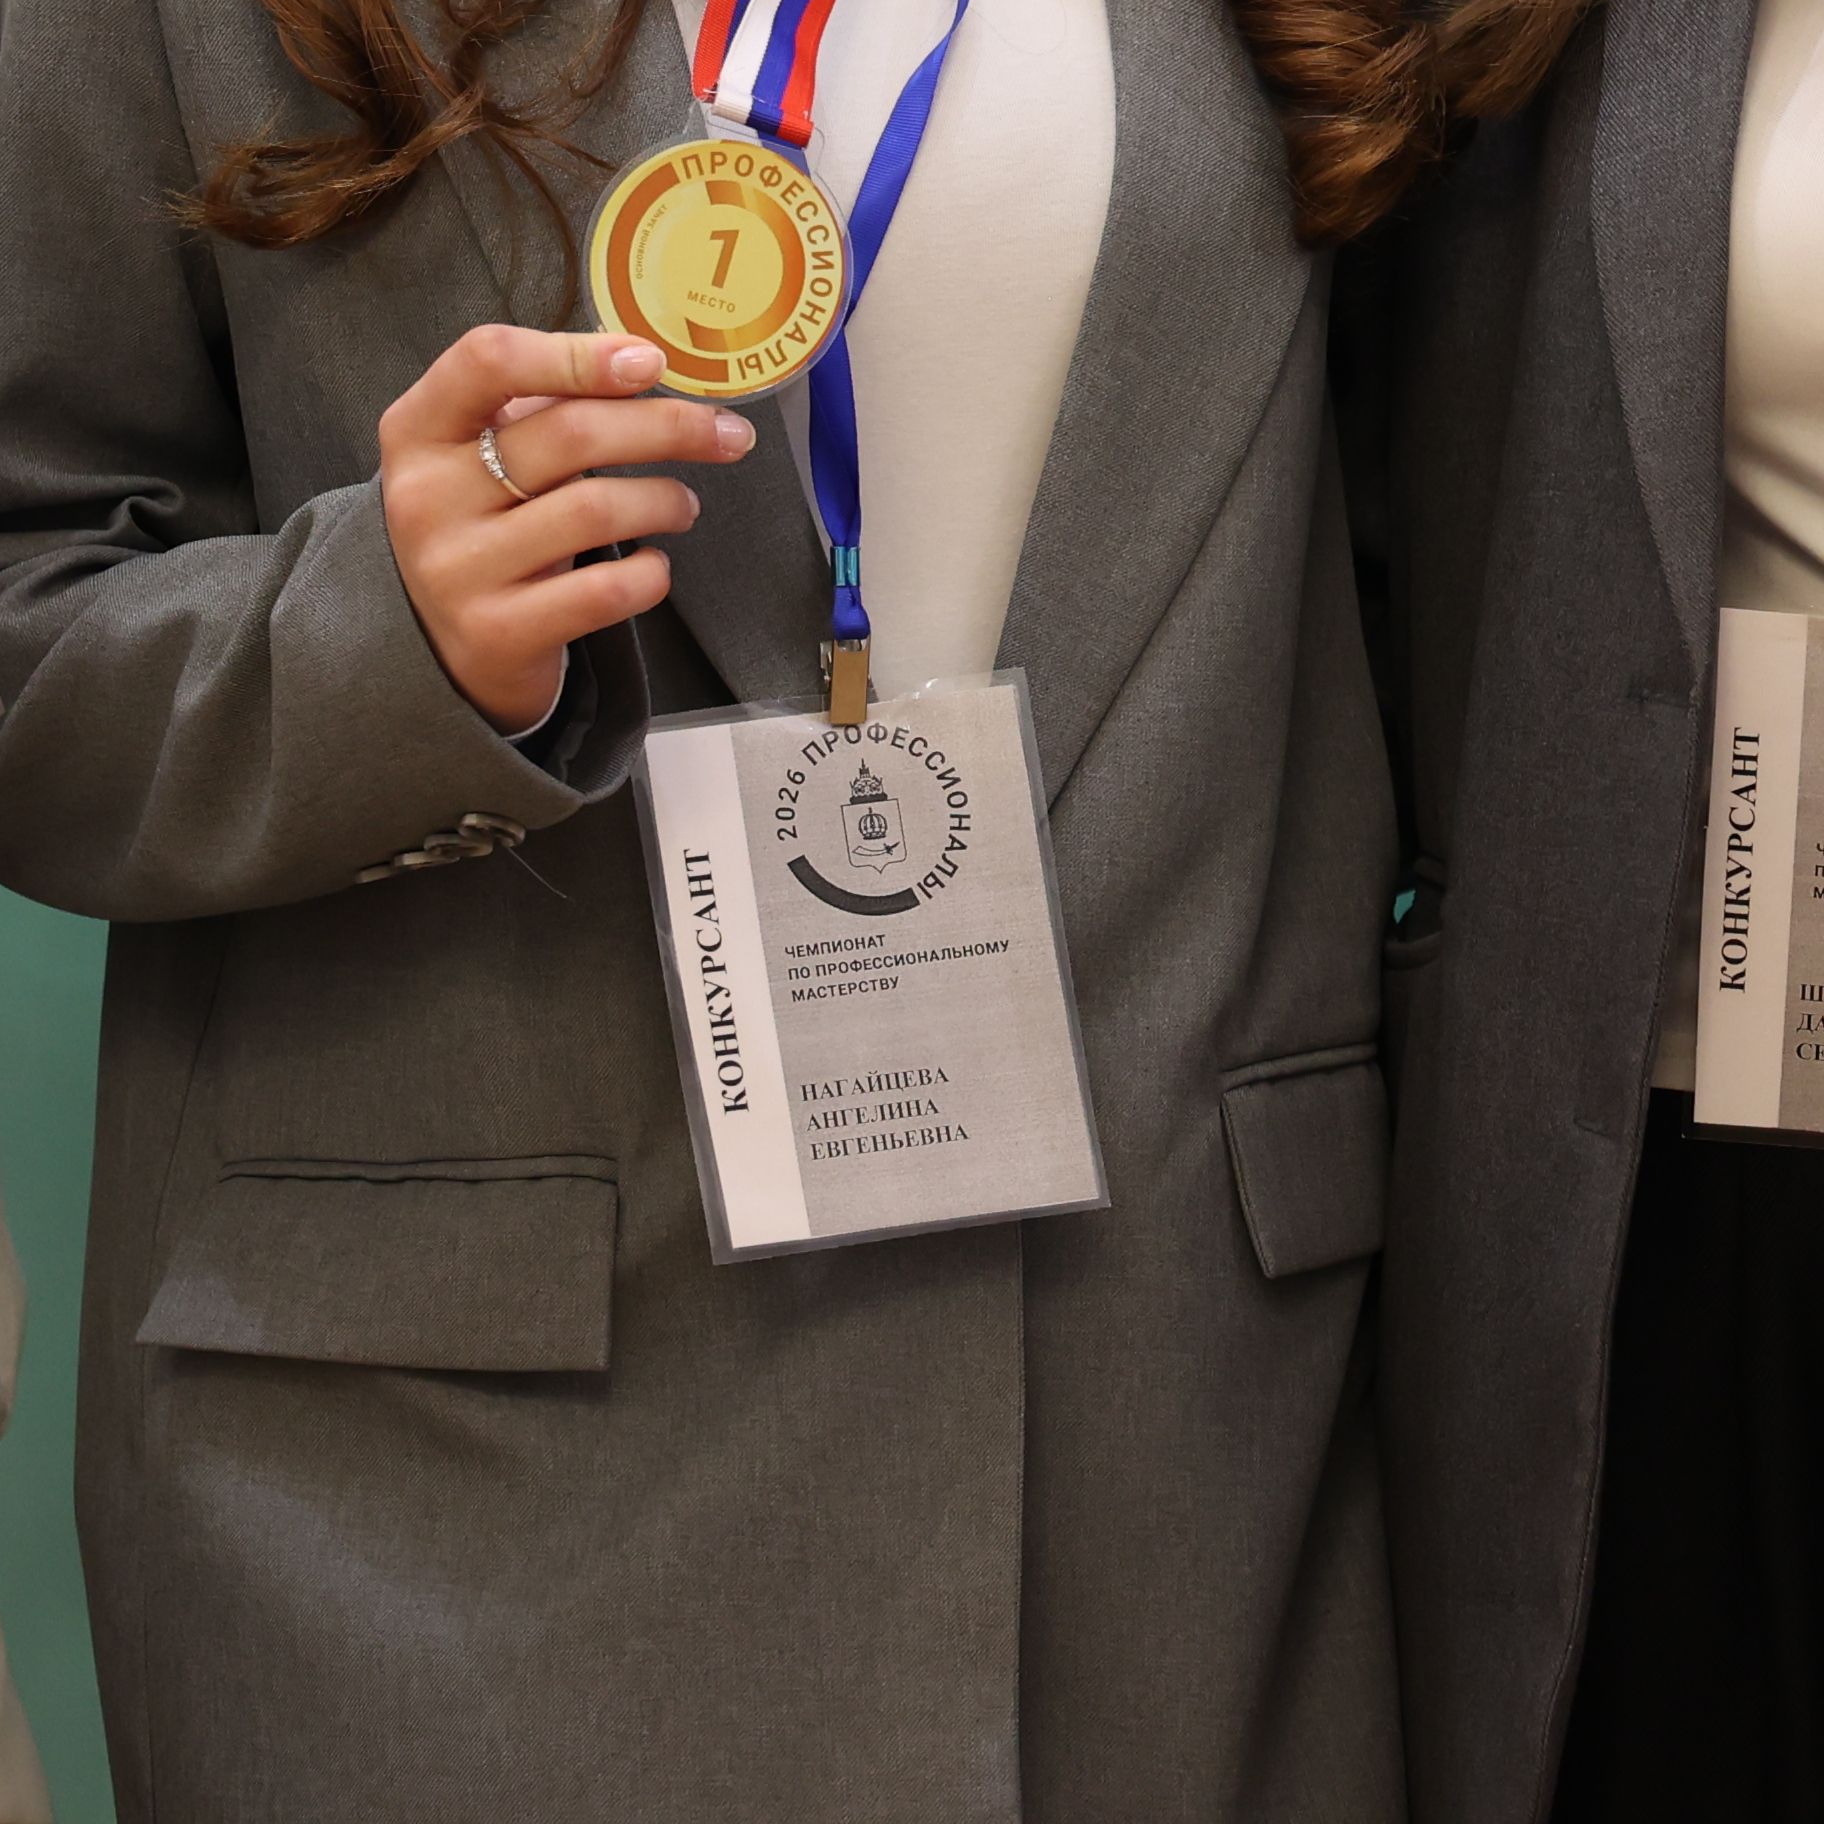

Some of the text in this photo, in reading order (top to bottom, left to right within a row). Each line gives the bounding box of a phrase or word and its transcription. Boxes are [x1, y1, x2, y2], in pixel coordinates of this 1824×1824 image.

[680, 150, 836, 381] ПРОФЕССИОНАЛЫ
[708, 228, 740, 290] 1
[686, 289, 737, 314] МЕСТО
[775, 721, 972, 901] 2026 ПРОФЕССИОНАЛЫ
[1719, 726, 1760, 994] КОНКУРСАНТ
[784, 933, 886, 959] ЧЕМПИОНАТ
[787, 939, 1010, 981] ПО ПРОФЕССИОНАЛЬНОМУ
[683, 847, 750, 1116] КОНКУРСАНТ
[791, 975, 900, 1003] МАСТЕРСТВУ
[800, 1066, 950, 1102] НАГАЙЦЕВА
[806, 1098, 941, 1132] АНГЕЛИНА
[810, 1124, 970, 1161] ЕВГЕНЬЕВНА
